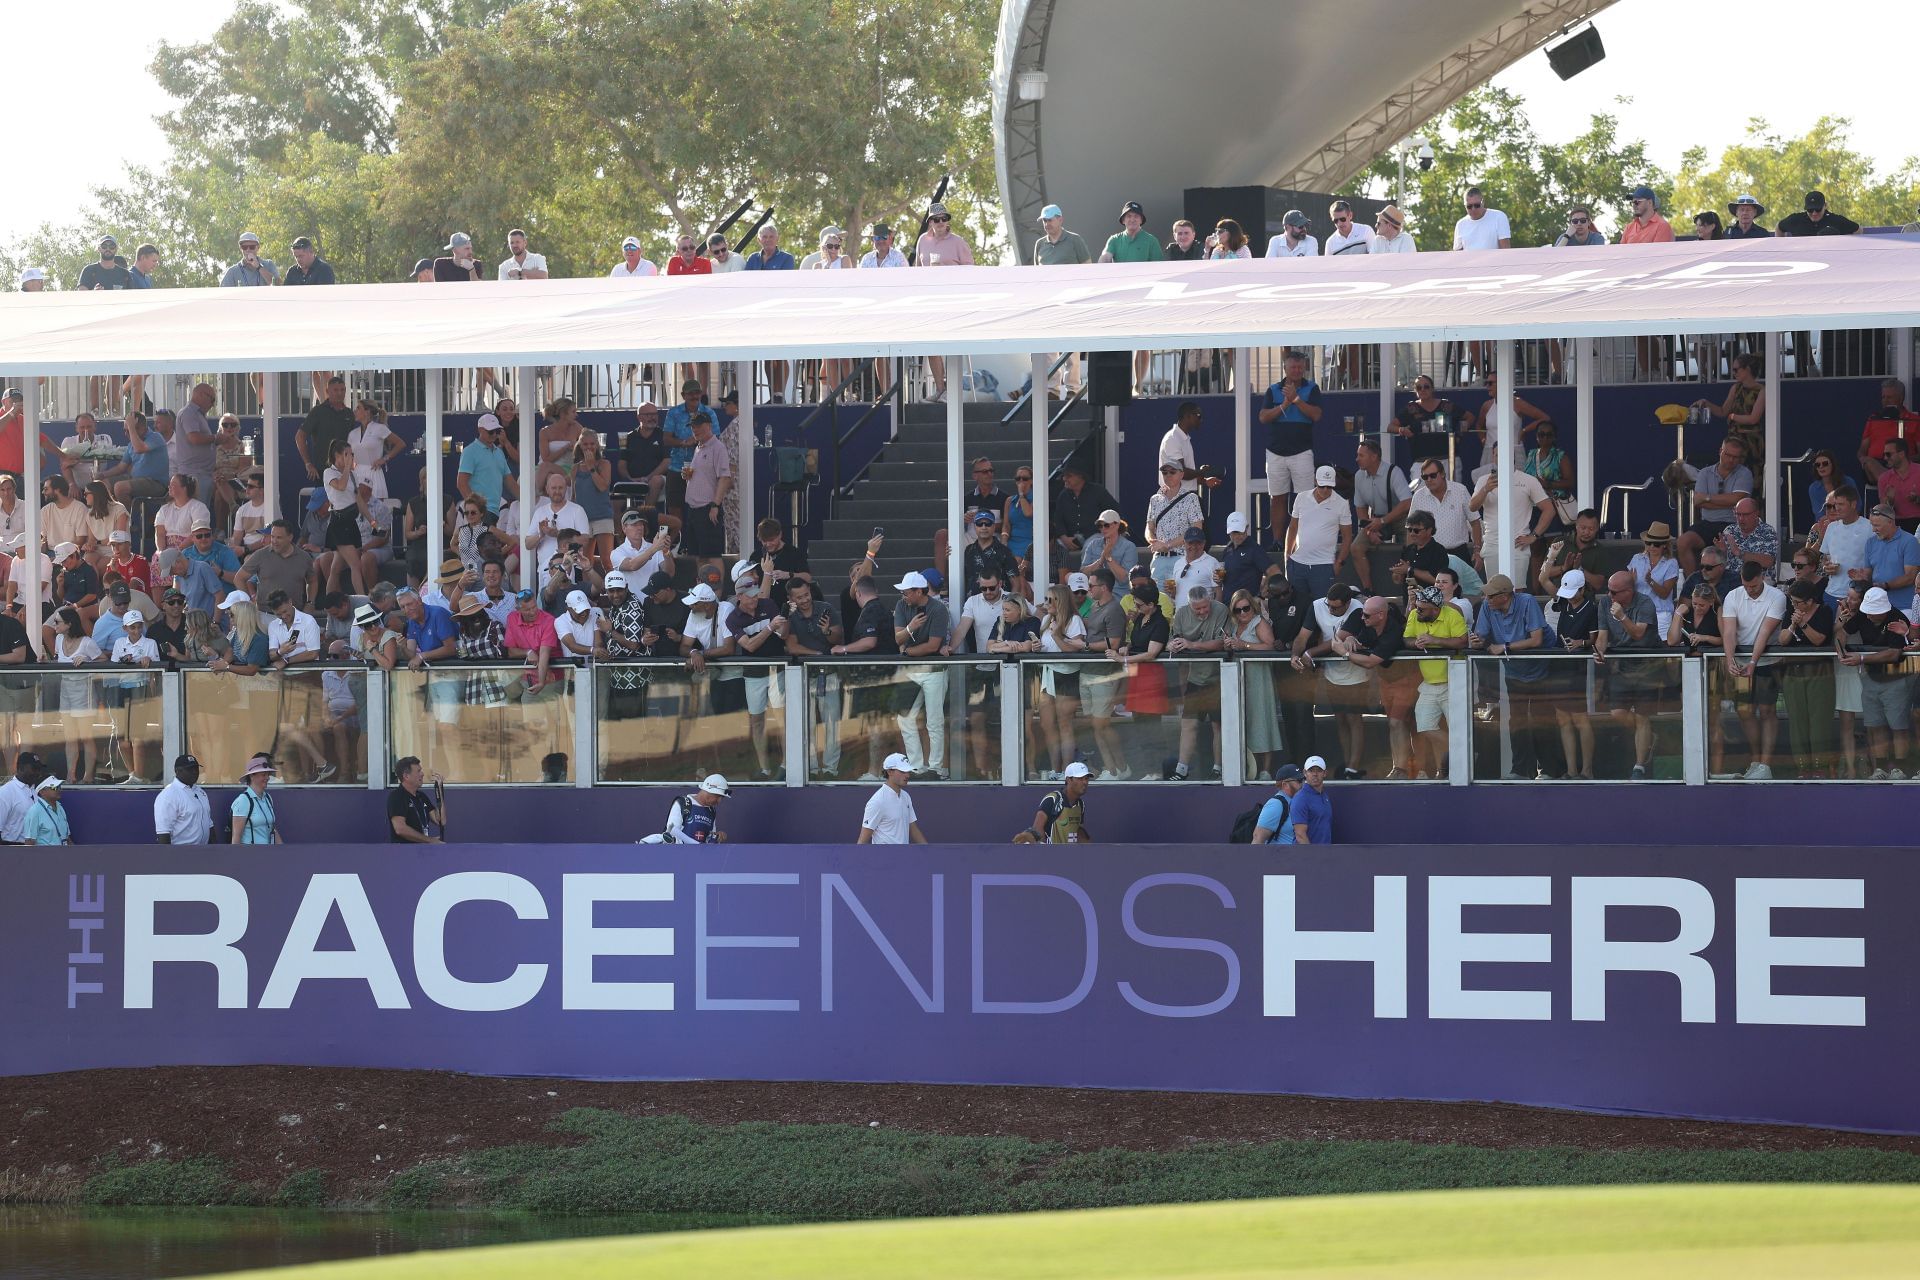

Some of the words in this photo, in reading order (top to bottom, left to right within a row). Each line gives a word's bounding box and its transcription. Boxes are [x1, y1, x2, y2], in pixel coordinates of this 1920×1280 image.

[1046, 260, 1830, 305] WORLD
[68, 873, 105, 1008] THE
[123, 871, 675, 1012] RACE
[695, 872, 1241, 1018] ENDS
[1263, 874, 1866, 1026] HERE
